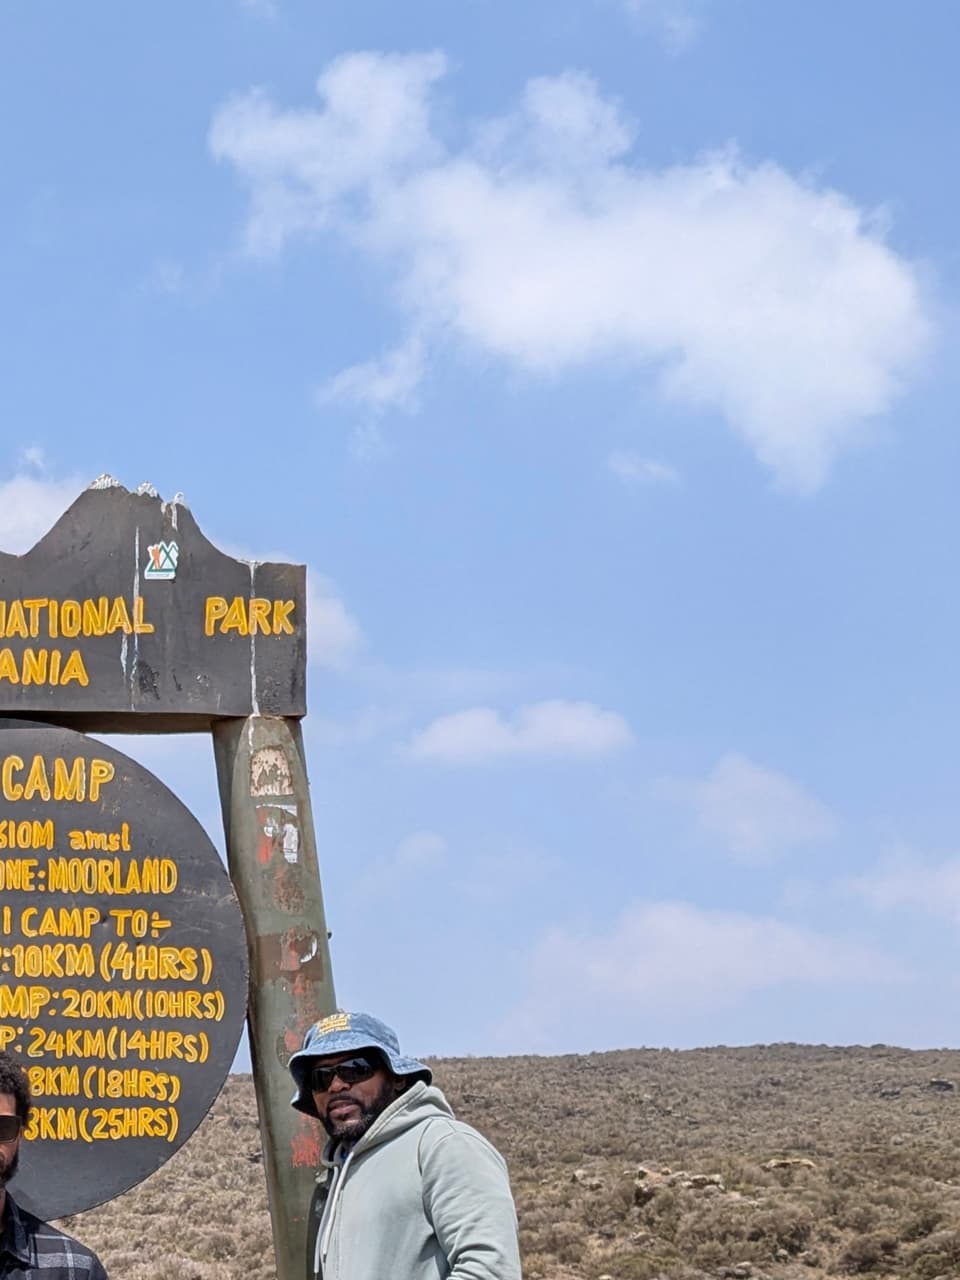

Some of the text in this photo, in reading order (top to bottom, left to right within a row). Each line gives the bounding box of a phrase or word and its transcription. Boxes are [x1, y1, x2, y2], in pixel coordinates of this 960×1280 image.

[204, 596, 296, 637] PARK
[67, 821, 132, 852] amsl
[2, 904, 13, 936] I
[20, 906, 101, 939] CAMP
